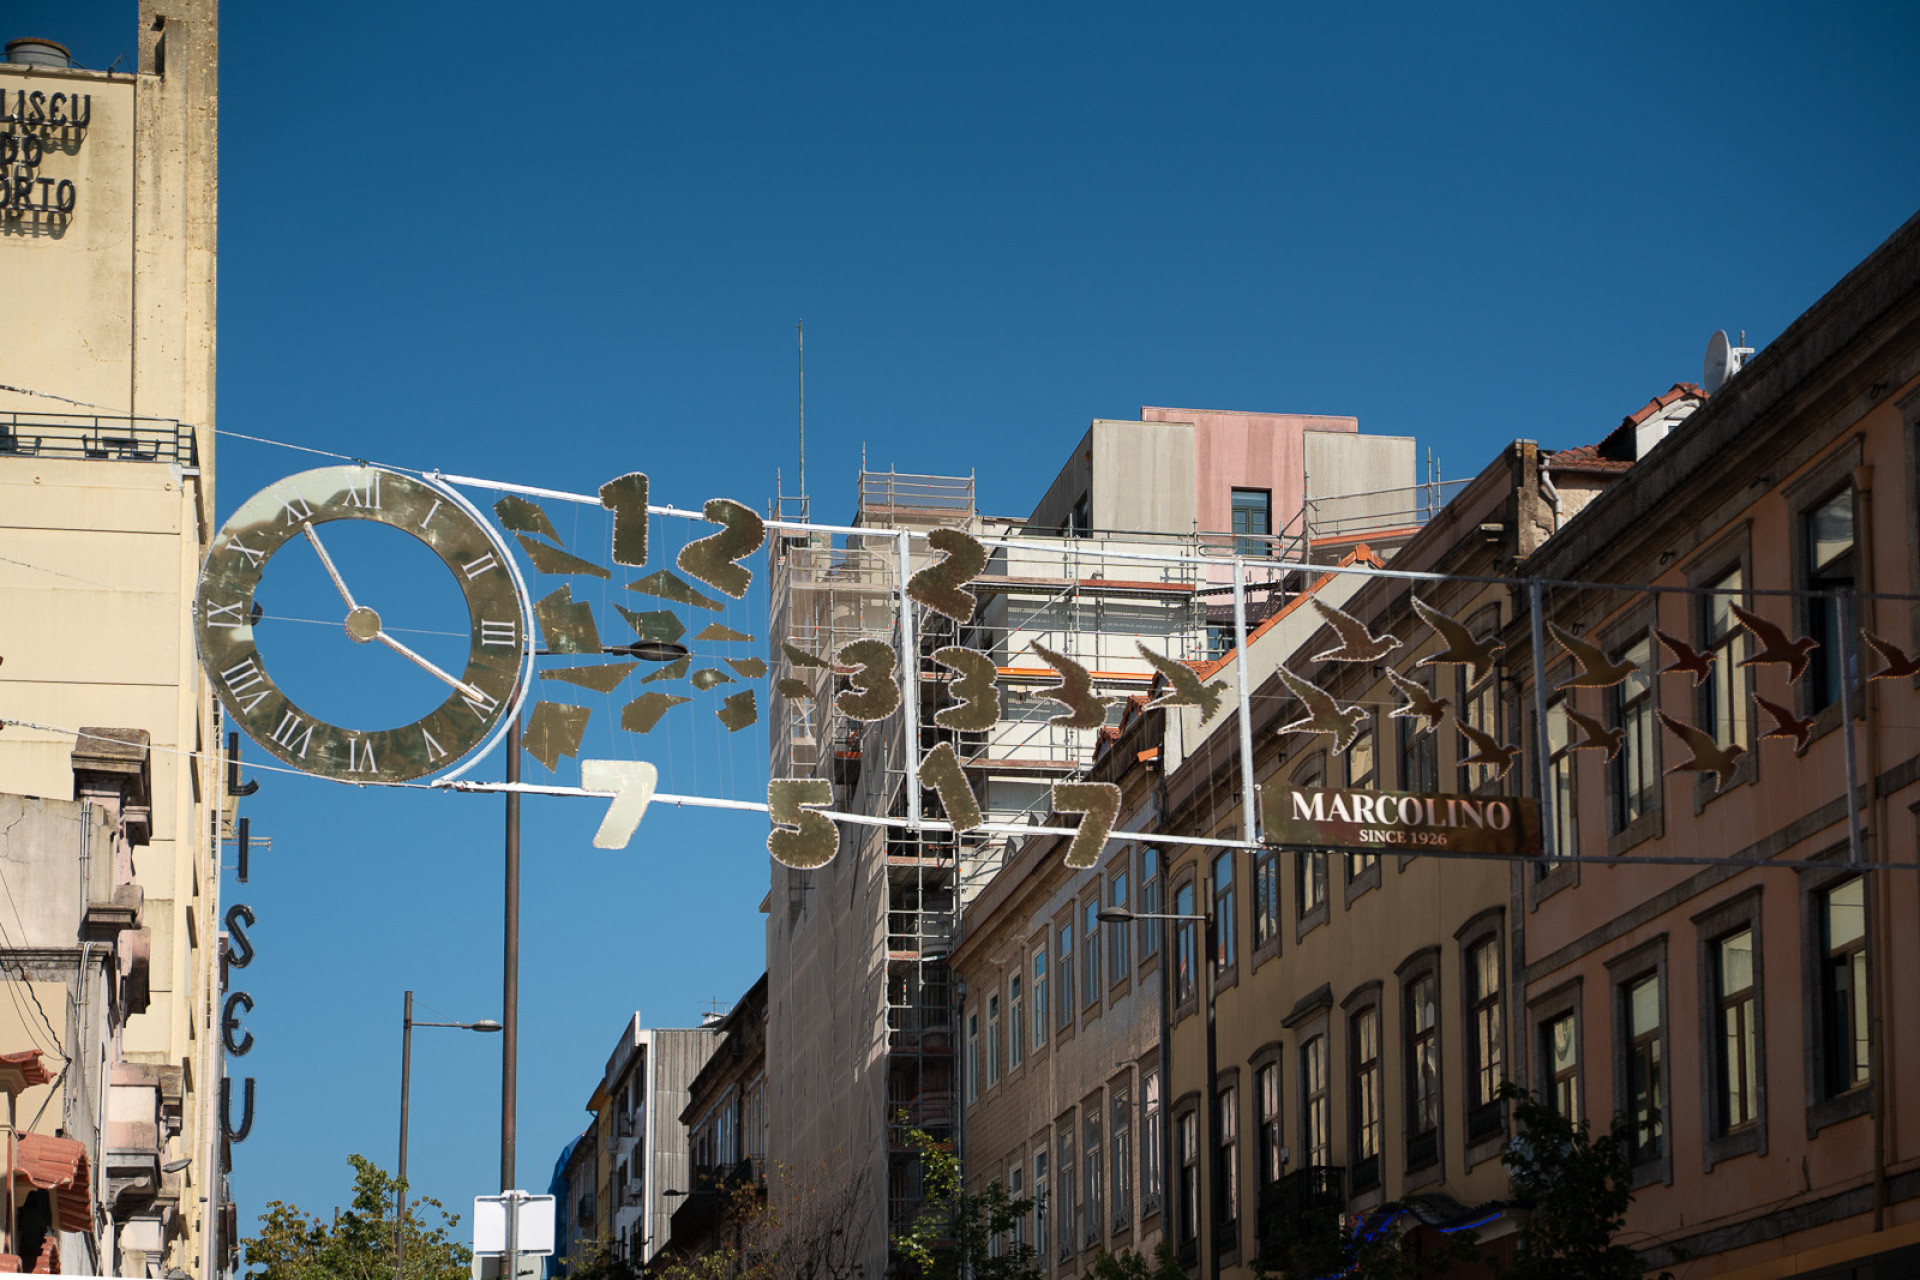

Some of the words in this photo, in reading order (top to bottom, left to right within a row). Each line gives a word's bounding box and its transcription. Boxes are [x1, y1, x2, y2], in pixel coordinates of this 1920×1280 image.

[342, 473, 382, 509] XII
[1291, 791, 1511, 830] MARCOLINO
[1359, 829, 1407, 844] SINCE
[1410, 831, 1448, 846] 1926
